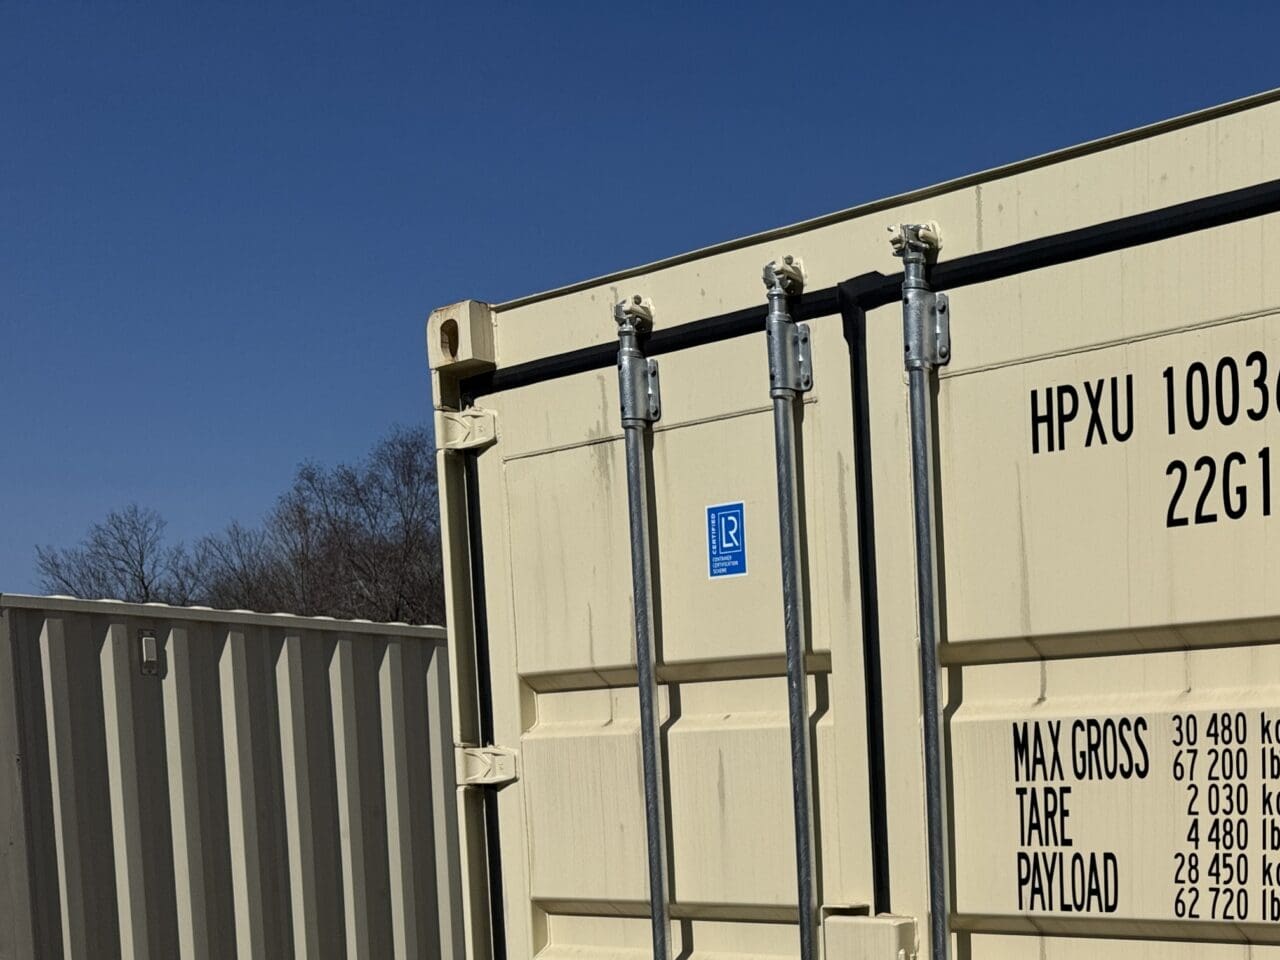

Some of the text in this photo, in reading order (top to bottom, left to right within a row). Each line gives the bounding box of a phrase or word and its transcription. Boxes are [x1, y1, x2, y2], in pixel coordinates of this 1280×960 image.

[1031, 374, 1133, 454] HPXU
[1166, 447, 1271, 528] 22G1
[721, 516, 739, 548] LR
[1013, 720, 1064, 782] MAX
[1072, 718, 1149, 780] GROSS
[1172, 714, 1198, 746] 30
[1207, 712, 1247, 745] 480
[1173, 747, 1280, 781] 67 200 lb
[1016, 787, 1073, 847] TARE
[1187, 784, 1199, 816] 2
[1208, 783, 1248, 816] 030
[1187, 818, 1280, 851] 4 480 lb
[1017, 851, 1119, 912] PAYLOAD
[1174, 853, 1199, 885] 28
[1208, 853, 1248, 886] 450
[1175, 887, 1280, 922] 62 720 lb
